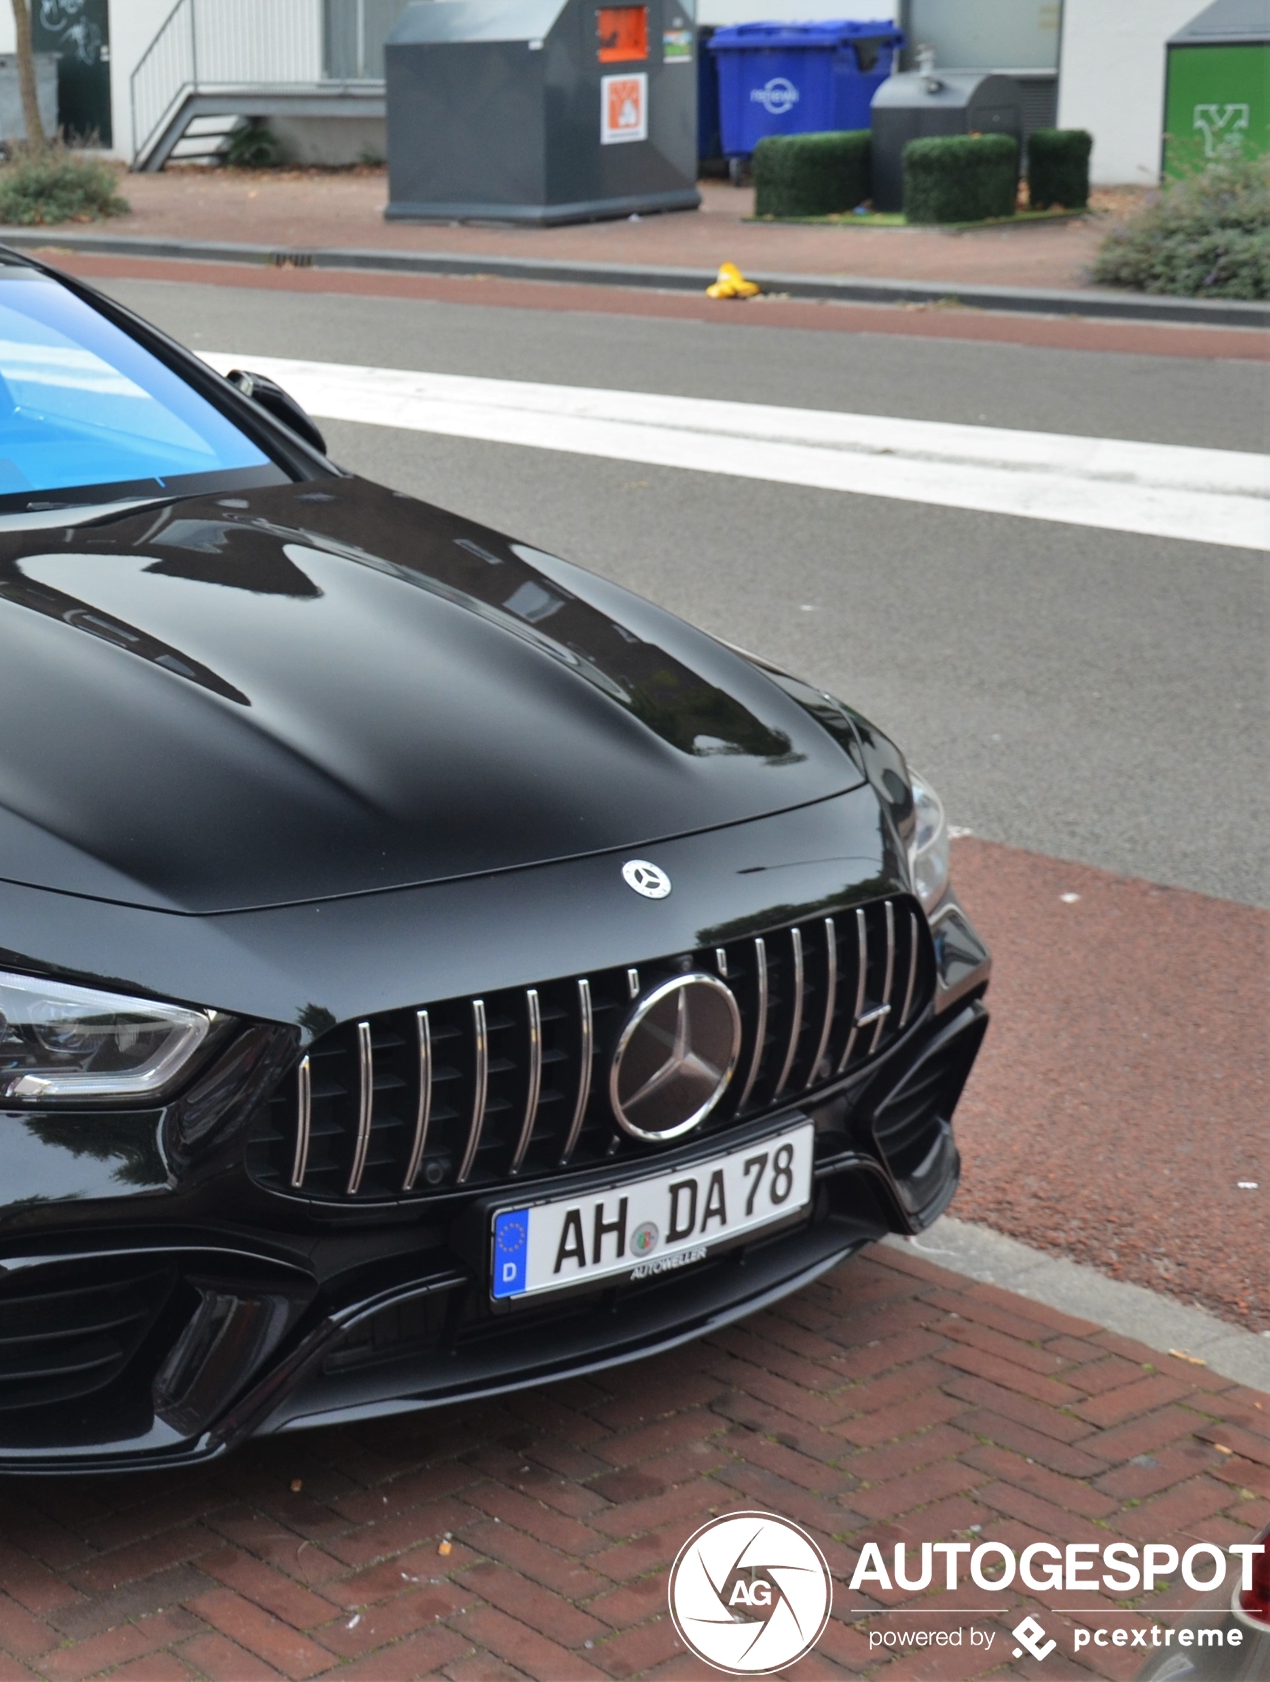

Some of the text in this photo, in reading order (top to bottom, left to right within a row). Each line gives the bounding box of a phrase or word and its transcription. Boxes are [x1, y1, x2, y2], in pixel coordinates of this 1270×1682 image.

[553, 1143, 794, 1274] AH DA 78
[502, 1261, 517, 1282] D
